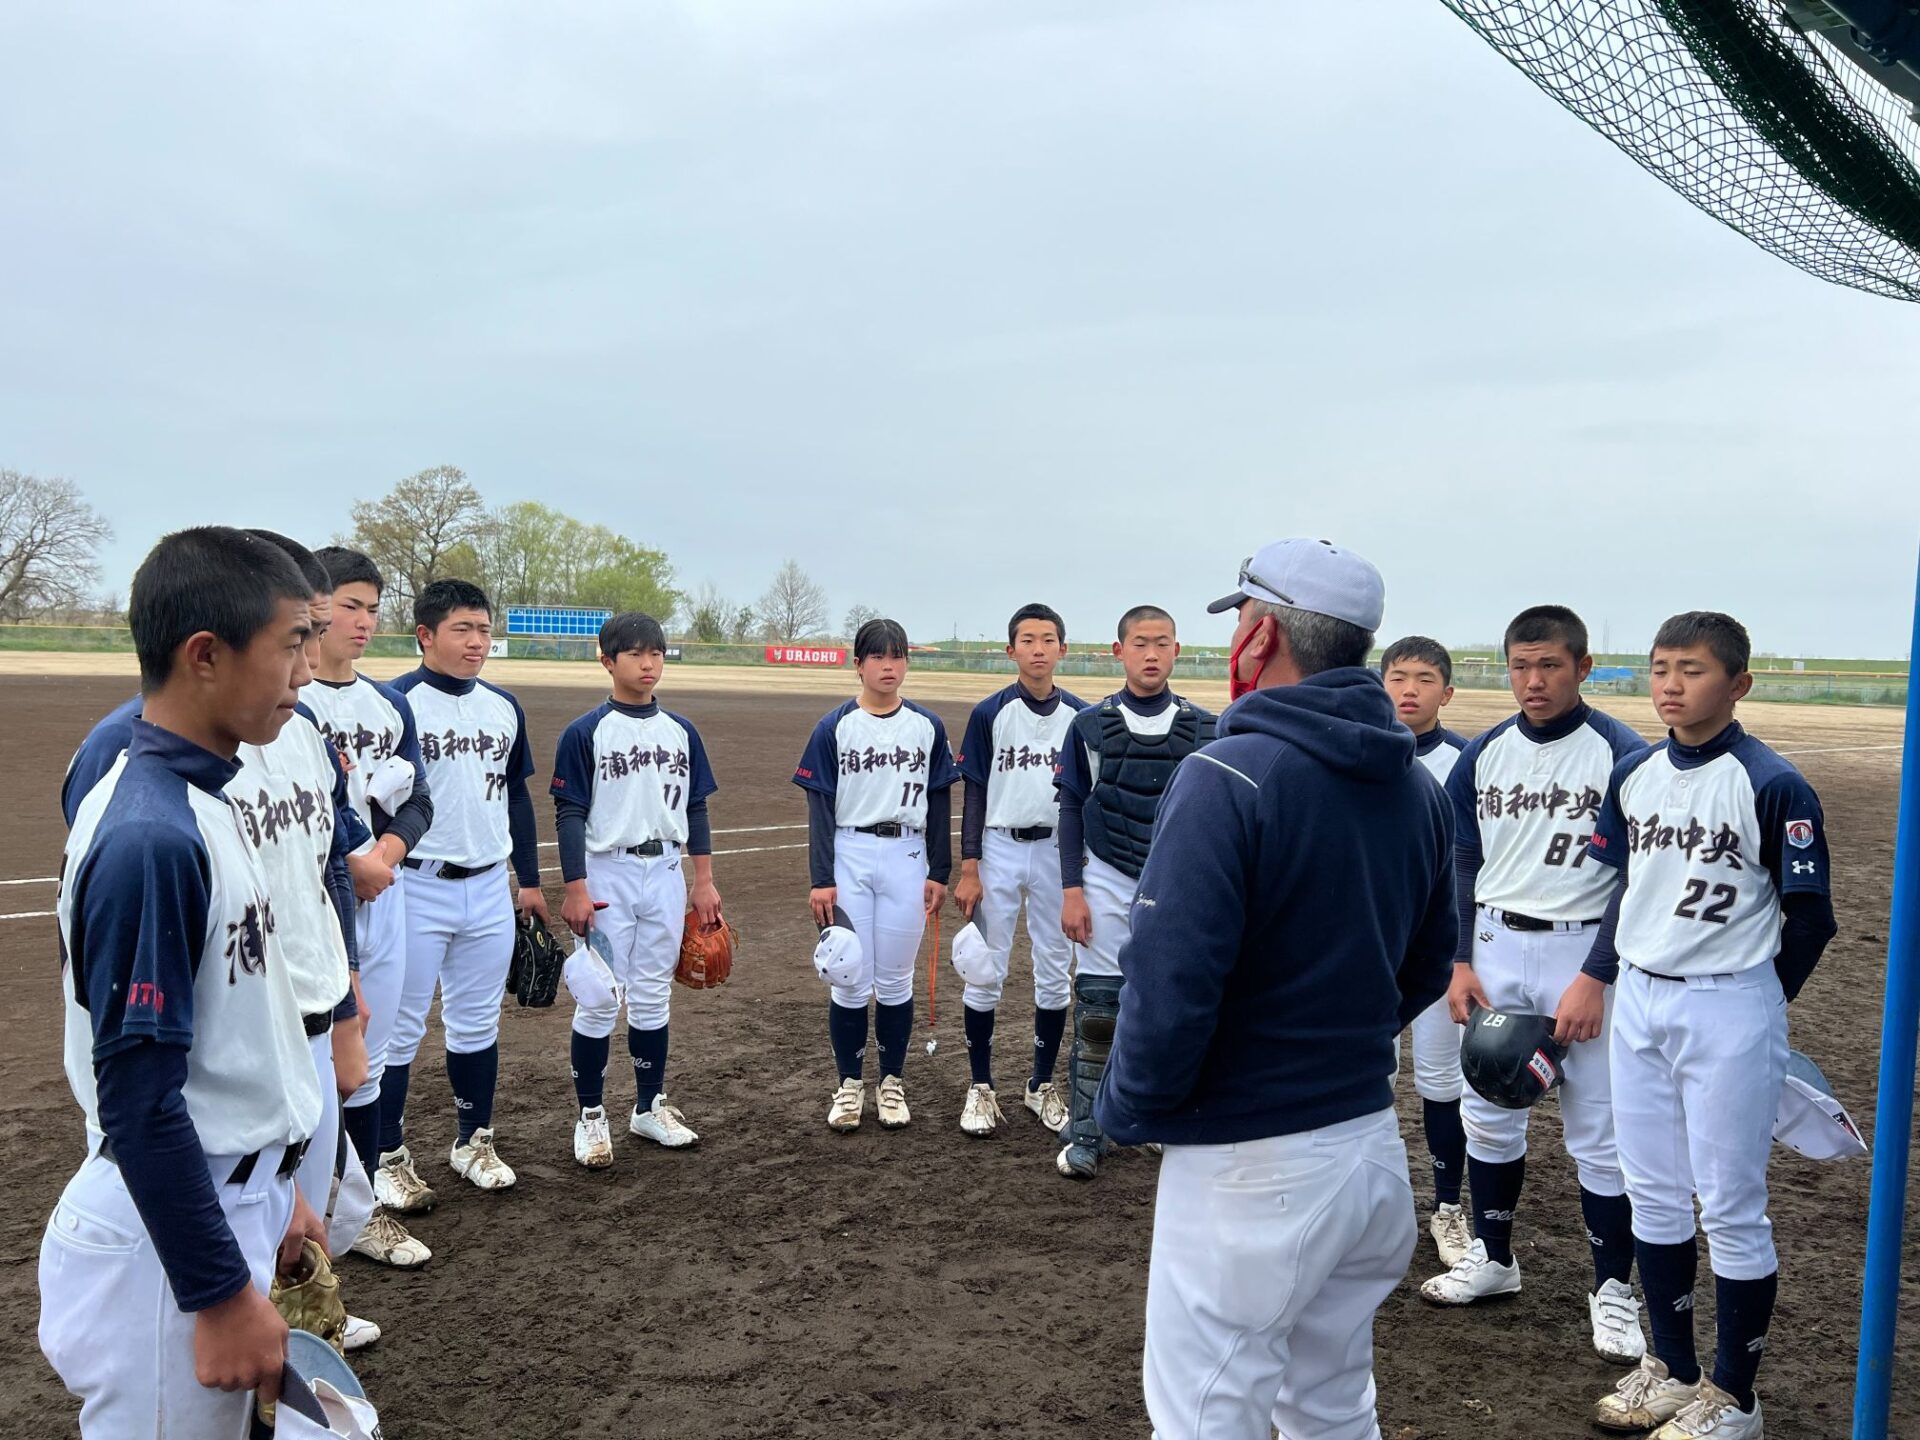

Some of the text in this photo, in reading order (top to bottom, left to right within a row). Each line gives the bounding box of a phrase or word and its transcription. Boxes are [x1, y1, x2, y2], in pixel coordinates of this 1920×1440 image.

[600, 744, 689, 780] 浦和中央
[840, 745, 926, 776] 浦和中央
[663, 783, 681, 810] 11
[900, 782, 924, 807] 17
[1477, 782, 1602, 821] 浦和中央
[1544, 832, 1592, 868] 87
[1674, 878, 1737, 924] 22
